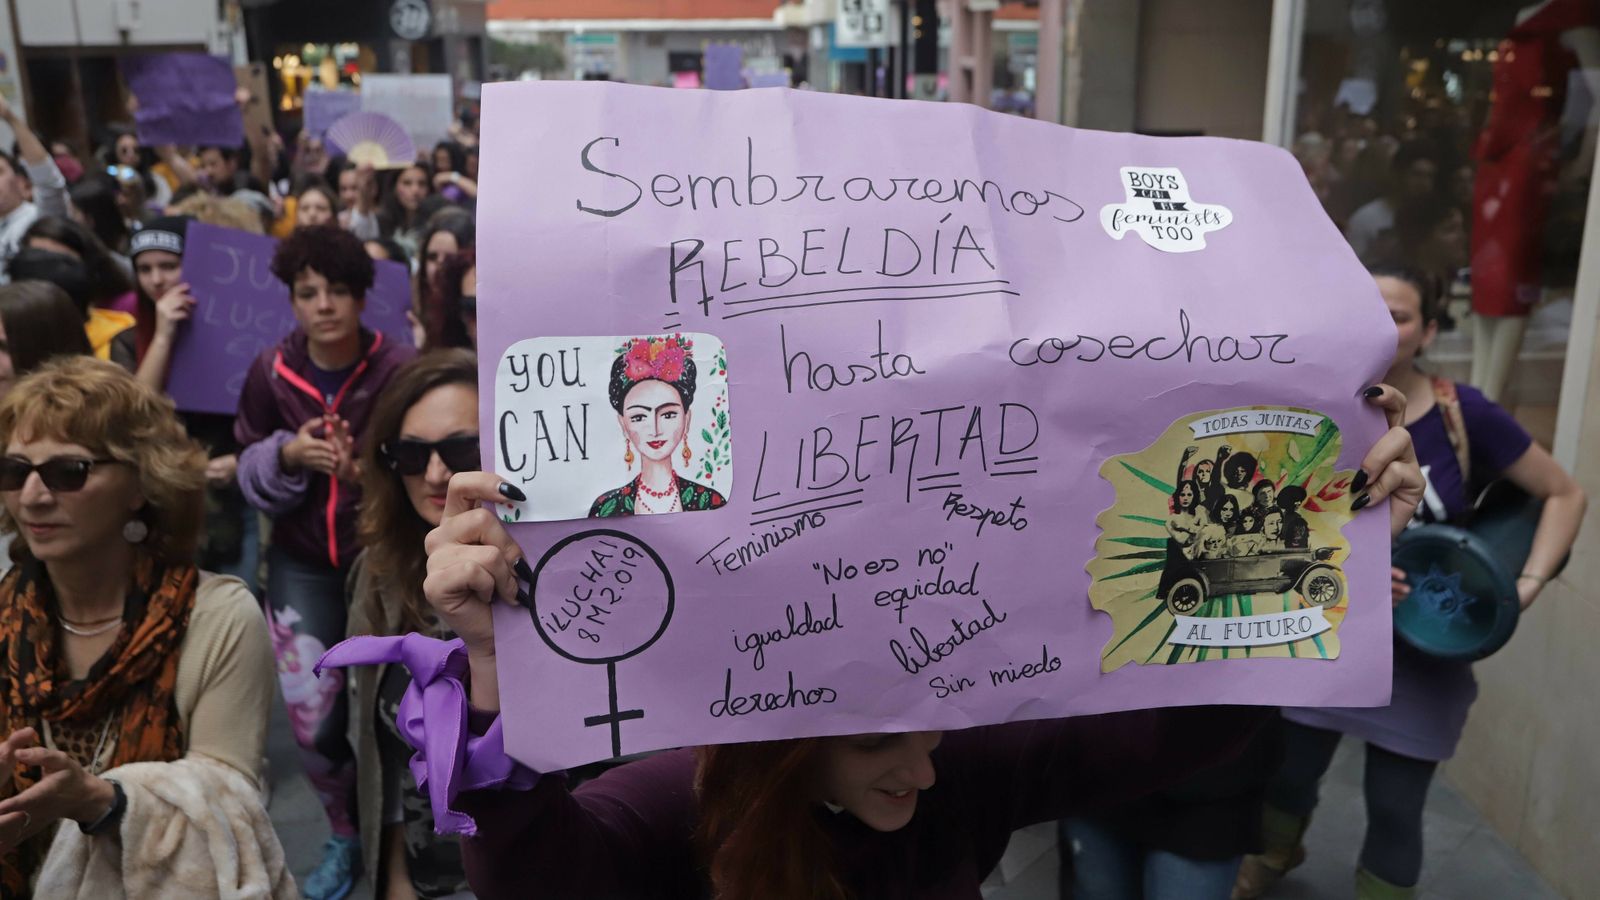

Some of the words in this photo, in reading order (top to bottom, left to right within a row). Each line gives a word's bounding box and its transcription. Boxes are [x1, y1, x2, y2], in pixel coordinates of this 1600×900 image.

[577, 137, 1085, 222] Sembraremos
[1128, 171, 1179, 190] BOYS
[1112, 208, 1224, 232] feminists
[1151, 225, 1193, 240] TOO
[669, 213, 995, 316] REBELDÍA
[781, 319, 926, 393] hasta
[1009, 308, 1295, 366] cosechar
[499, 403, 590, 484] CAN
[1202, 414, 1248, 434] TODAS
[1255, 412, 1313, 431] JUNTAS
[753, 403, 1039, 503] LIBERTAD
[943, 492, 1027, 537] Respeto
[696, 511, 826, 575] Feminismo
[864, 558, 899, 576] es
[874, 561, 980, 624] equidad
[733, 593, 844, 671] igualdad
[890, 599, 1007, 674] libertad
[1186, 623, 1212, 641] AL
[1223, 614, 1313, 641] FUTURO
[709, 668, 837, 717] derechos
[989, 645, 1062, 687] miedo
